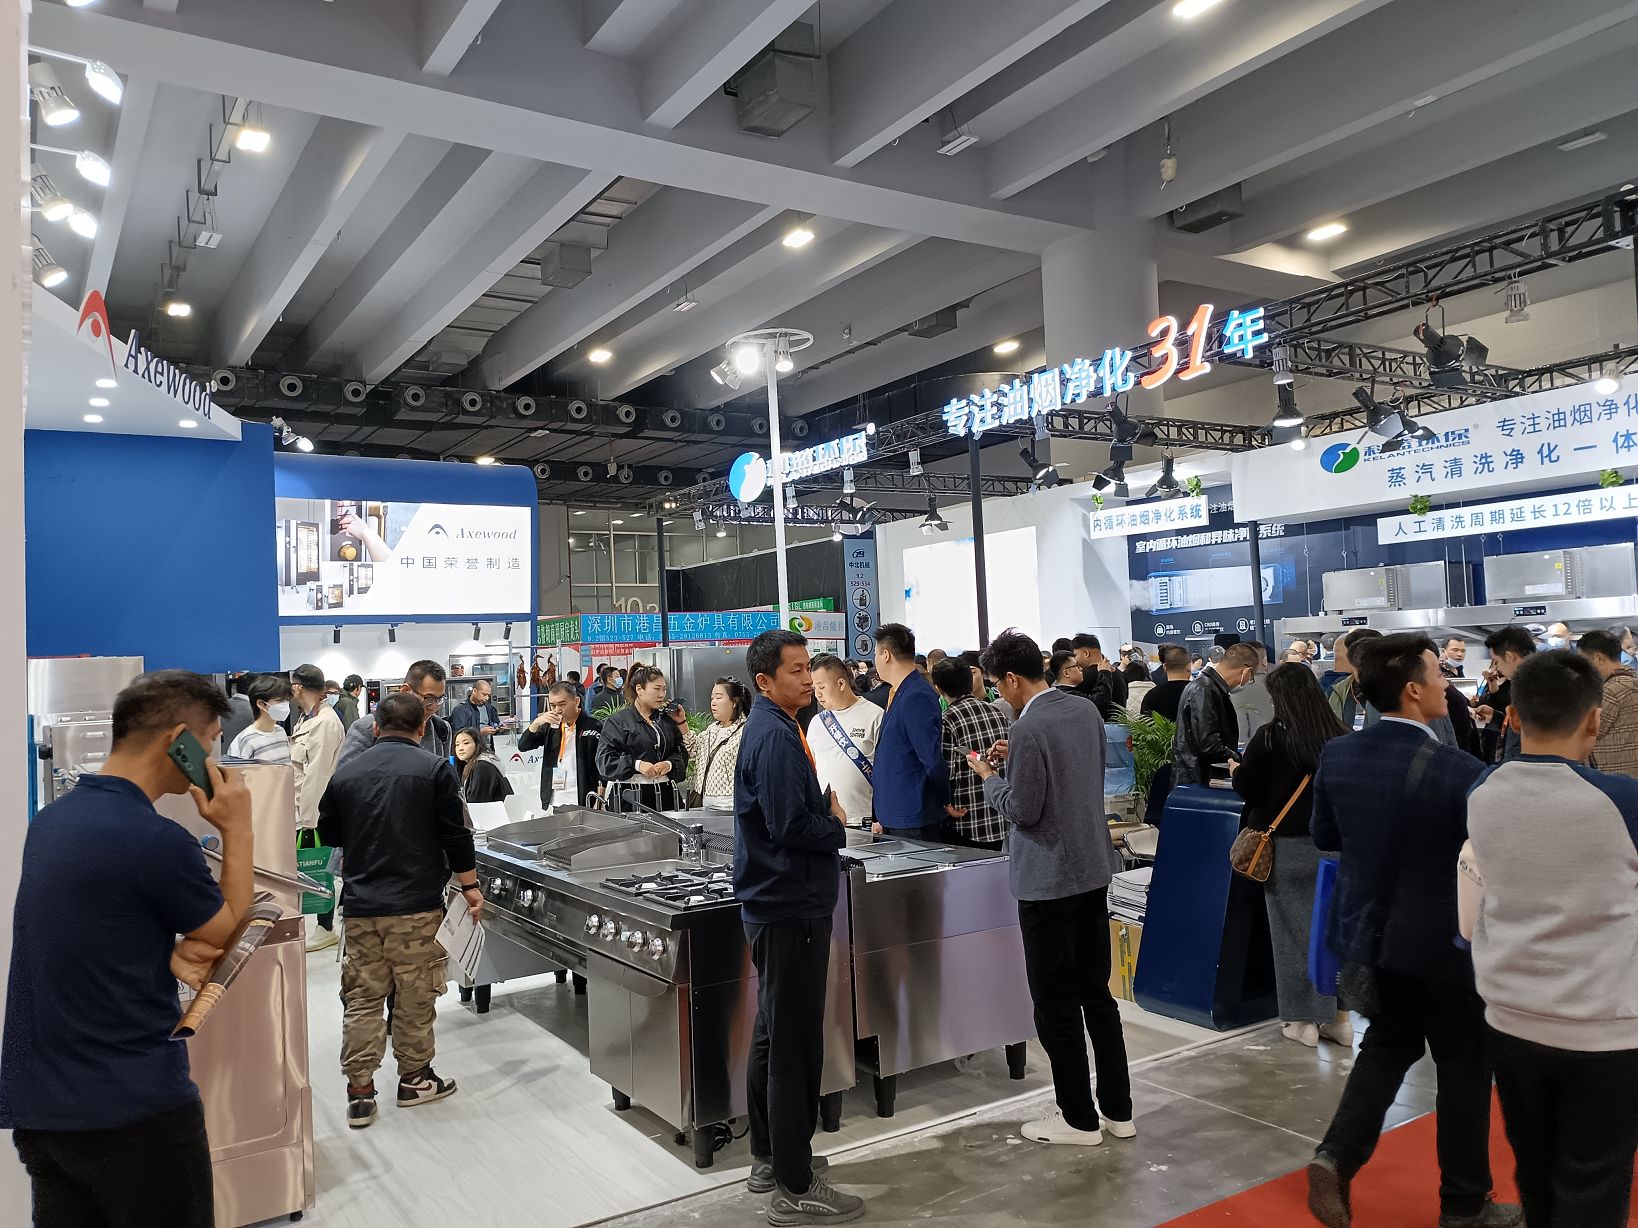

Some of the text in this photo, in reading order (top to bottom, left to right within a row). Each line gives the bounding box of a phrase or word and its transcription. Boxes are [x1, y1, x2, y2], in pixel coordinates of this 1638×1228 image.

[124, 329, 212, 420] Axewood
[1363, 440, 1471, 462] KELANTECHNICS
[1388, 429, 1638, 488] 蒸汽清洗净化一体
[1093, 503, 1203, 533] 内循环油烟净化系统
[456, 528, 517, 540] Axewood
[400, 555, 521, 570] 中国荣誉制造
[587, 613, 780, 634] 深圳市港昌五金炉具有限公司
